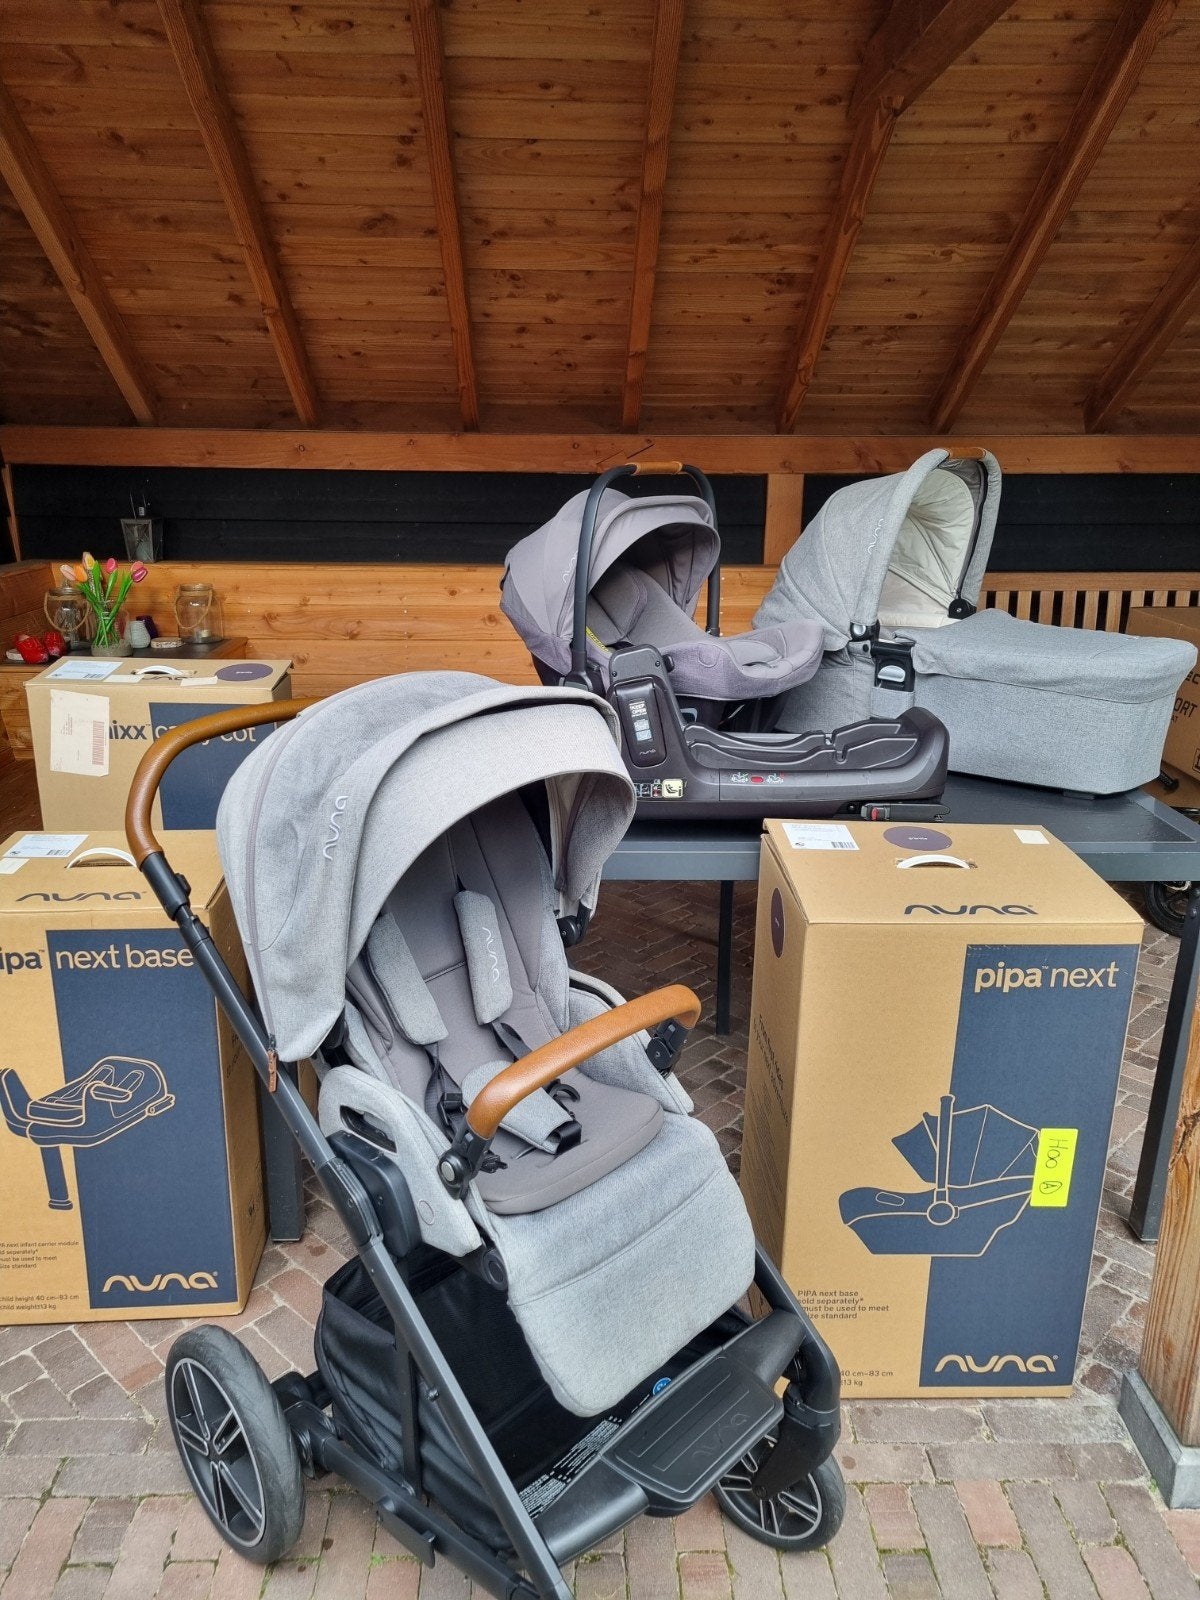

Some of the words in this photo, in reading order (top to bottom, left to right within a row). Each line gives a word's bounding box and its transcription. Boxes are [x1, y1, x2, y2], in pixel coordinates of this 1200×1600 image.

[322, 795, 349, 861] nuna
[15, 891, 142, 902] nuna
[904, 904, 1039, 916] nuna
[55, 944, 120, 970] next
[125, 943, 195, 969] base
[482, 926, 501, 983] nuna
[1050, 961, 1120, 988] next
[102, 1270, 219, 1293] nuna
[820, 1312, 858, 1320] standard
[934, 1354, 1057, 1373] nuna
[853, 1379, 863, 1387] kg
